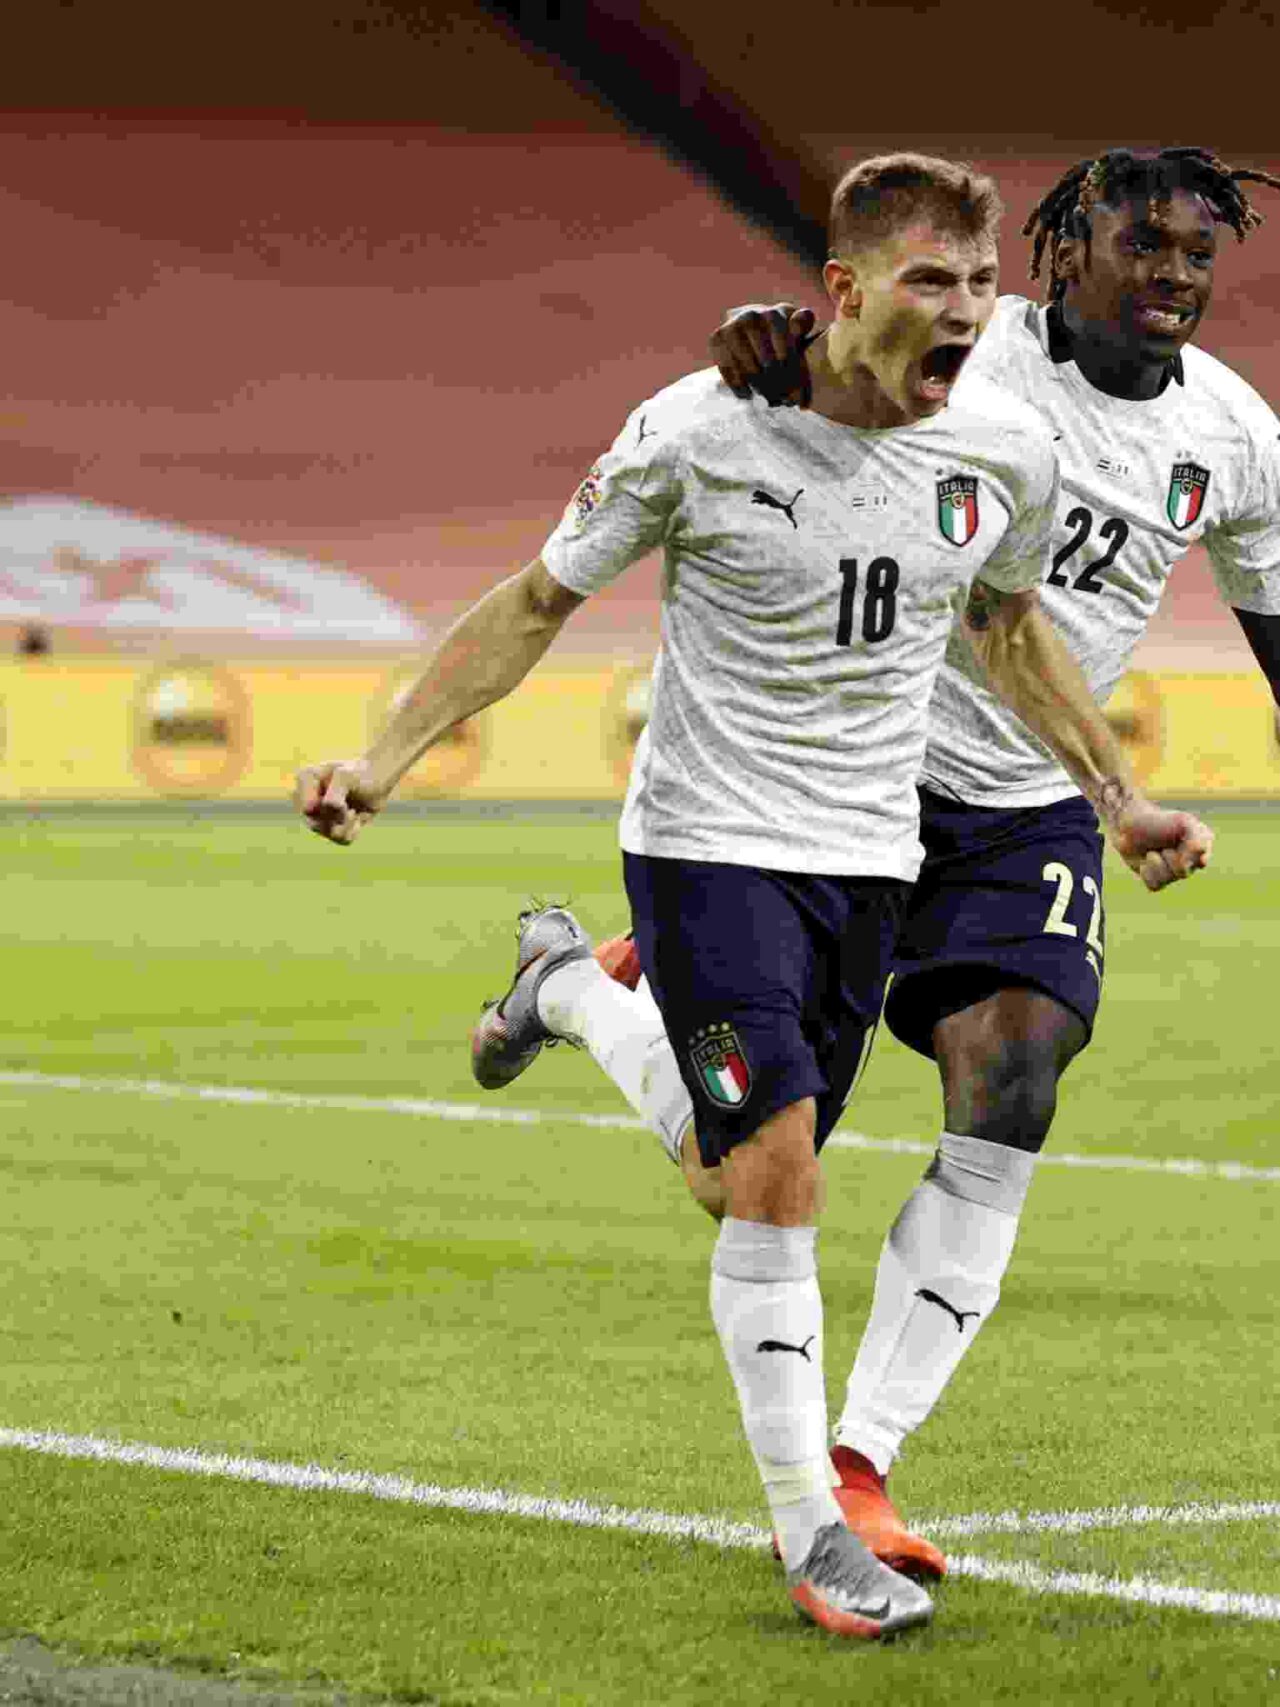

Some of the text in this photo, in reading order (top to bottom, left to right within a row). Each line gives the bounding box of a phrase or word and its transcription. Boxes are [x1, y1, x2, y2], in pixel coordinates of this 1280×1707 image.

[939, 480, 974, 495] ITALIA
[1047, 506, 1129, 593] 22
[836, 556, 900, 646] 18
